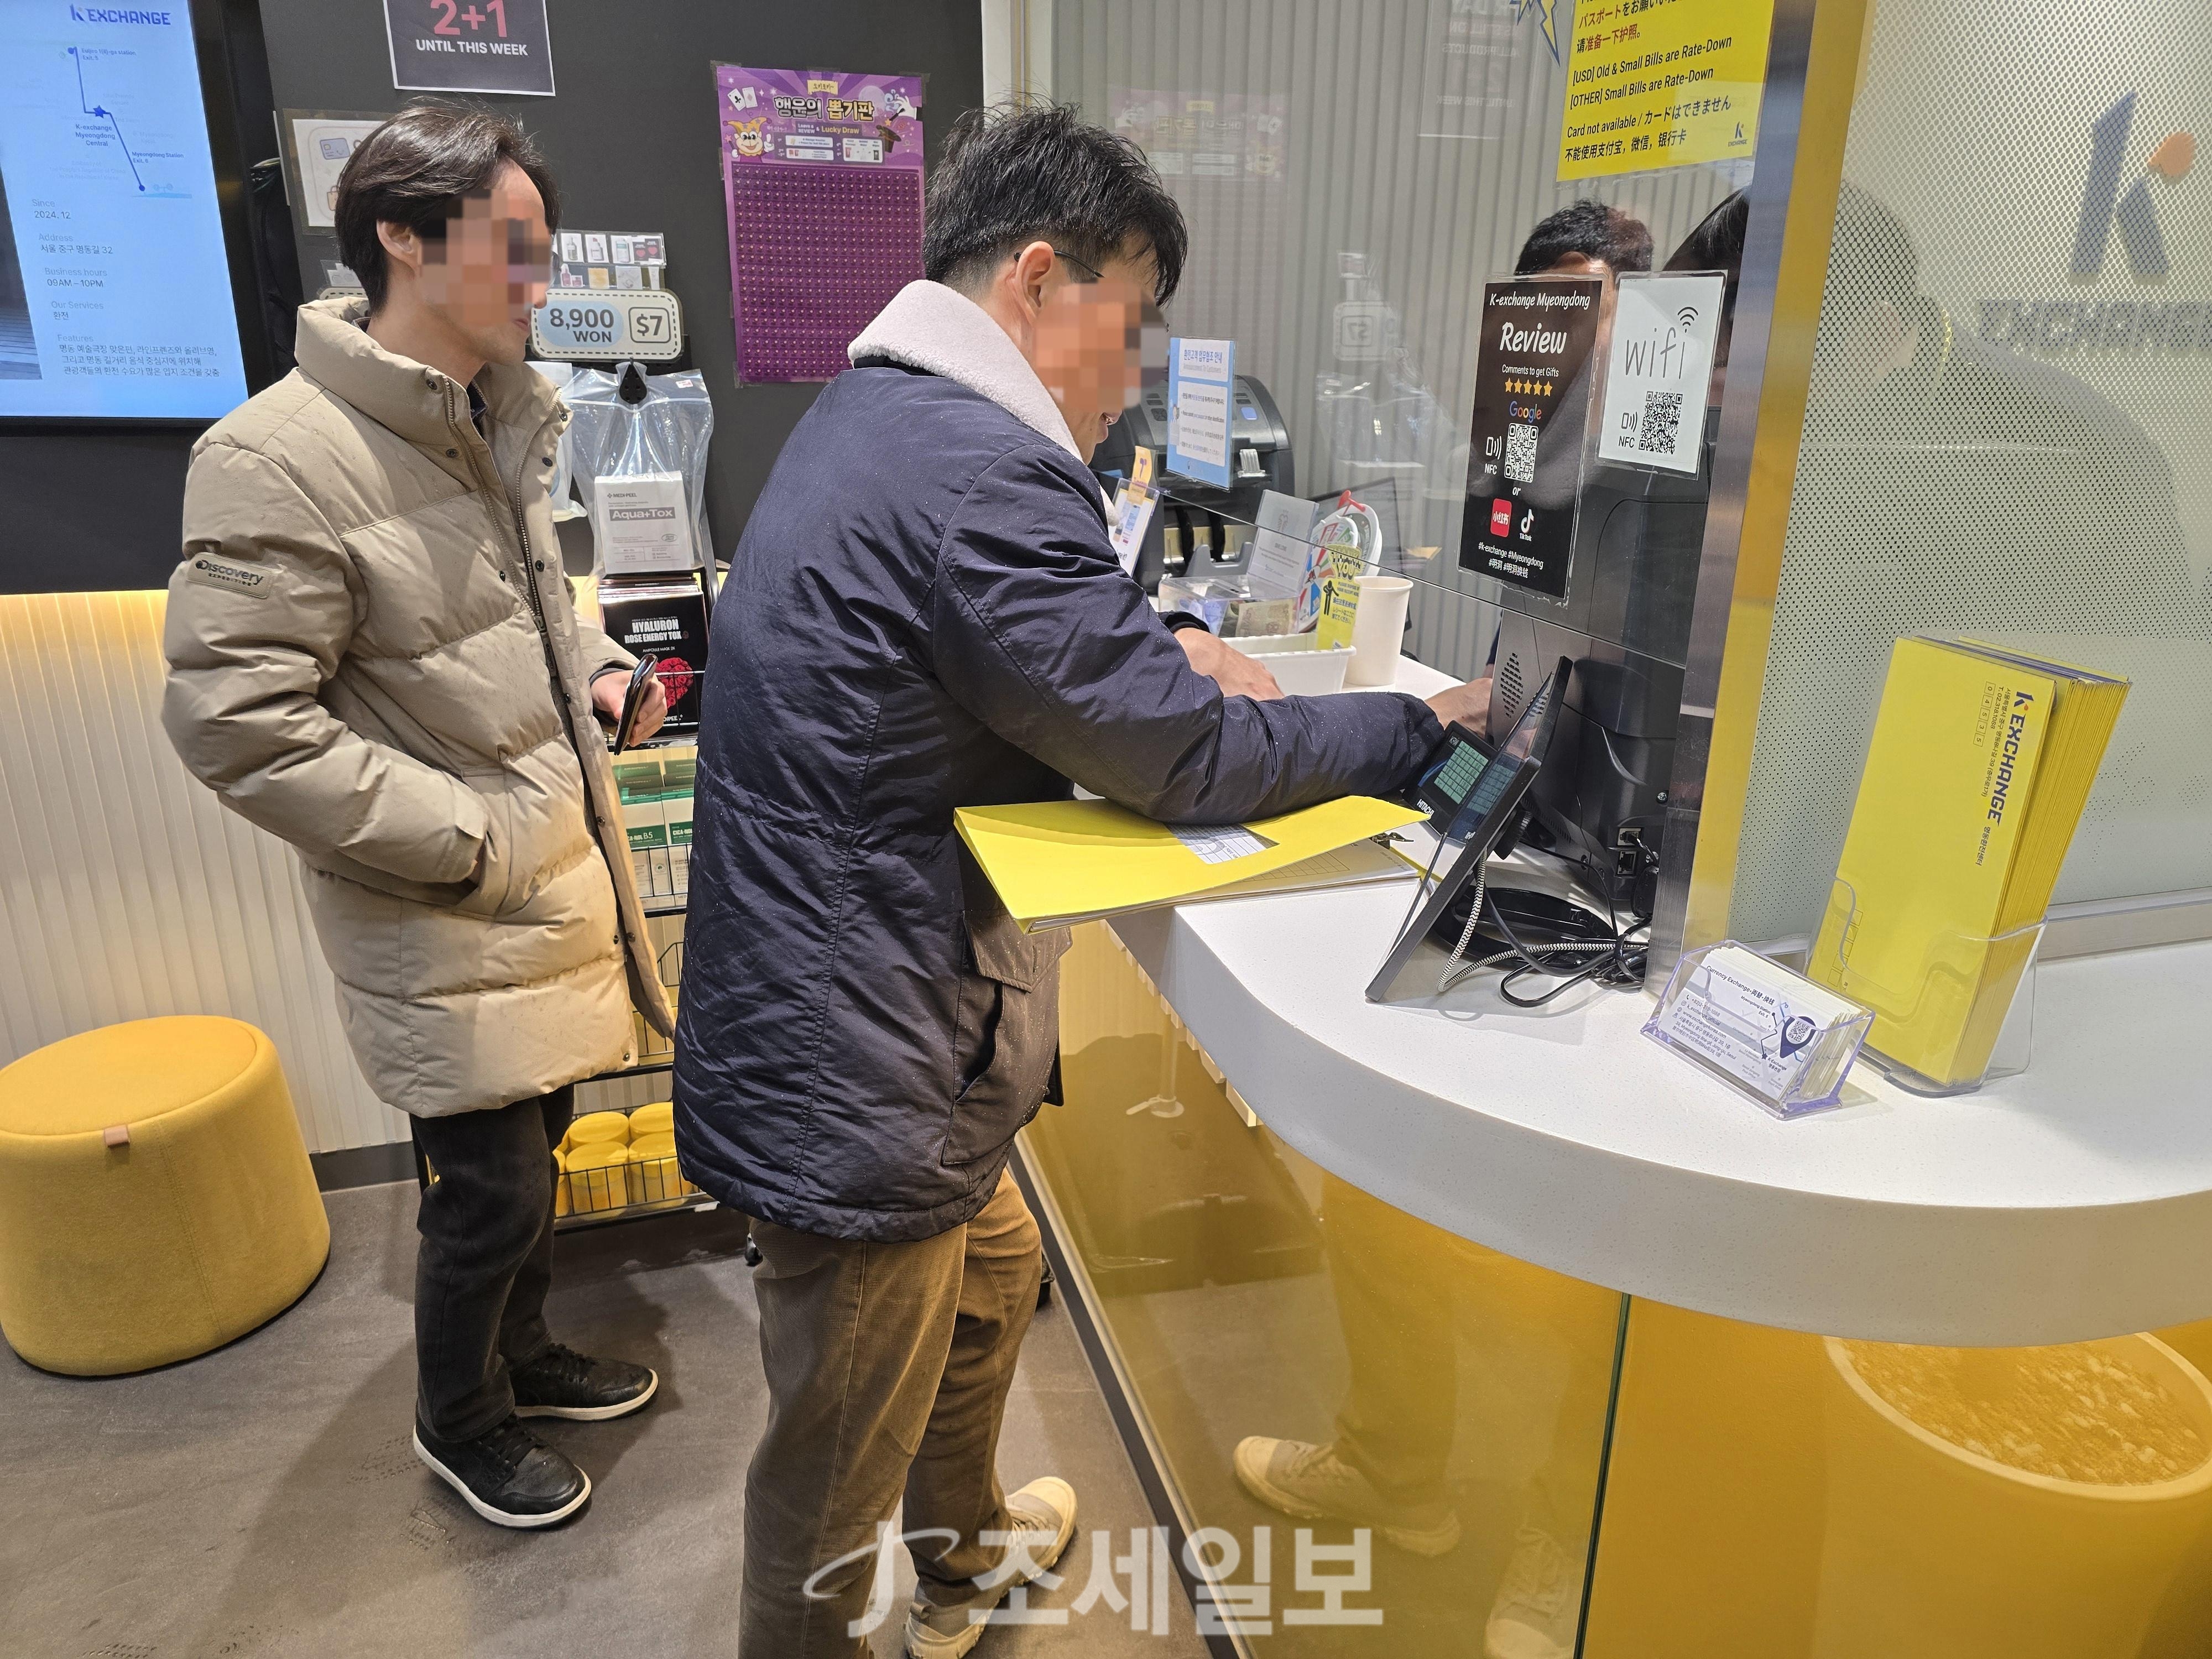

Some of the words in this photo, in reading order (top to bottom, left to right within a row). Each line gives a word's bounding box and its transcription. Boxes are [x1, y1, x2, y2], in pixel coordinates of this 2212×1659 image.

[85, 8, 171, 25] EXCHANGE
[431, 0, 507, 38] 2+1
[1577, 23, 1640, 54] 请准备一下护照。
[416, 39, 456, 53] UNTIL
[457, 41, 488, 54] THIS
[489, 43, 529, 56] WEEK
[1573, 66, 1594, 86] [USD]
[1597, 66, 1609, 79] Old
[1612, 63, 1617, 75] &
[1619, 56, 1642, 73] Small
[1644, 54, 1662, 68] Bills
[1665, 51, 1679, 63] are
[1682, 35, 1732, 59] Rate-Down
[1571, 89, 1602, 109] [OTHER]
[1605, 85, 1626, 101] Small
[1629, 81, 1647, 96] Bills
[1648, 79, 1662, 91] are
[1665, 67, 1714, 88] Rate-Down
[774, 96, 823, 120] 행운의
[827, 98, 875, 122] 뽑기판
[1568, 124, 1585, 139] Card
[1587, 123, 1600, 135] not
[1601, 115, 1636, 132] available
[1638, 113, 1642, 127] /
[1644, 96, 1731, 125] カードはできません
[76, 124, 112, 132] K-exchange
[821, 126, 841, 134] Lucky
[76, 132, 116, 140] Myeongdong
[32, 199, 55, 208] Since
[39, 233, 73, 242] Address
[41, 244, 56, 254] 서울
[59, 244, 74, 254] 중구
[76, 245, 100, 254] 명동길
[47, 279, 72, 287] 09AM
[81, 279, 103, 288] 10PM
[51, 301, 66, 310] Our
[68, 301, 104, 310] Services
[1489, 291, 1535, 310] K-exchange
[1537, 290, 1590, 311] Myeongdong
[53, 311, 69, 321] 환전
[550, 309, 614, 330] 8,900
[636, 314, 663, 337] $7
[58, 334, 94, 343] Features
[573, 331, 612, 342] WON
[1499, 322, 1567, 354] Review
[59, 345, 75, 354] 명동
[77, 345, 107, 354] 예술극장
[109, 345, 135, 355] 맞은편,
[137, 346, 182, 356] 라인프렌즈와
[185, 346, 217, 356] 올리브영,
[1625, 327, 1687, 379] wifi
[62, 356, 85, 364] 그리고
[87, 356, 102, 365] 명동
[105, 356, 127, 365] 길거리
[129, 356, 144, 365] 음식
[146, 357, 176, 366] 중심지에
[179, 357, 201, 366] 위치해
[1214, 352, 1223, 364] 안내
[64, 366, 102, 375] 관광객들의
[105, 367, 119, 376] 환전
[122, 367, 144, 376] 수요가
[163, 367, 178, 377] 입지
[1502, 364, 1528, 375] Comments
[1530, 367, 1535, 375] to
[1536, 367, 1545, 378] get
[1546, 367, 1559, 377] Gifts
[1510, 400, 1542, 424] Google
[1618, 435, 1635, 448] NFC
[1485, 463, 1498, 475] NFC
[1512, 486, 1521, 496] or
[612, 509, 673, 520] Aqua+Tox
[1519, 533, 1532, 542] TikTok
[1478, 541, 1507, 558] #k-exchange
[1508, 550, 1544, 570] #Myeongdong
[195, 560, 264, 586] Discovery
[1336, 563, 1355, 581] YOU
[632, 619, 679, 633] HYALURON
[624, 634, 643, 644] ROSE
[643, 632, 667, 642] ENERGY
[668, 631, 682, 640] TOX
[2000, 688, 2011, 718] 서울특별시
[1991, 693, 2001, 729] 02.318.1088
[1989, 758, 1995, 766] 39
[1987, 713, 2026, 827] EXCHANGE
[1417, 799, 1435, 817] HITACHI
[1975, 826, 1991, 866] 명동환전센터
[1707, 966, 1728, 980] Currency
[1683, 1011, 1727, 1039] www.exchangekorea.com
